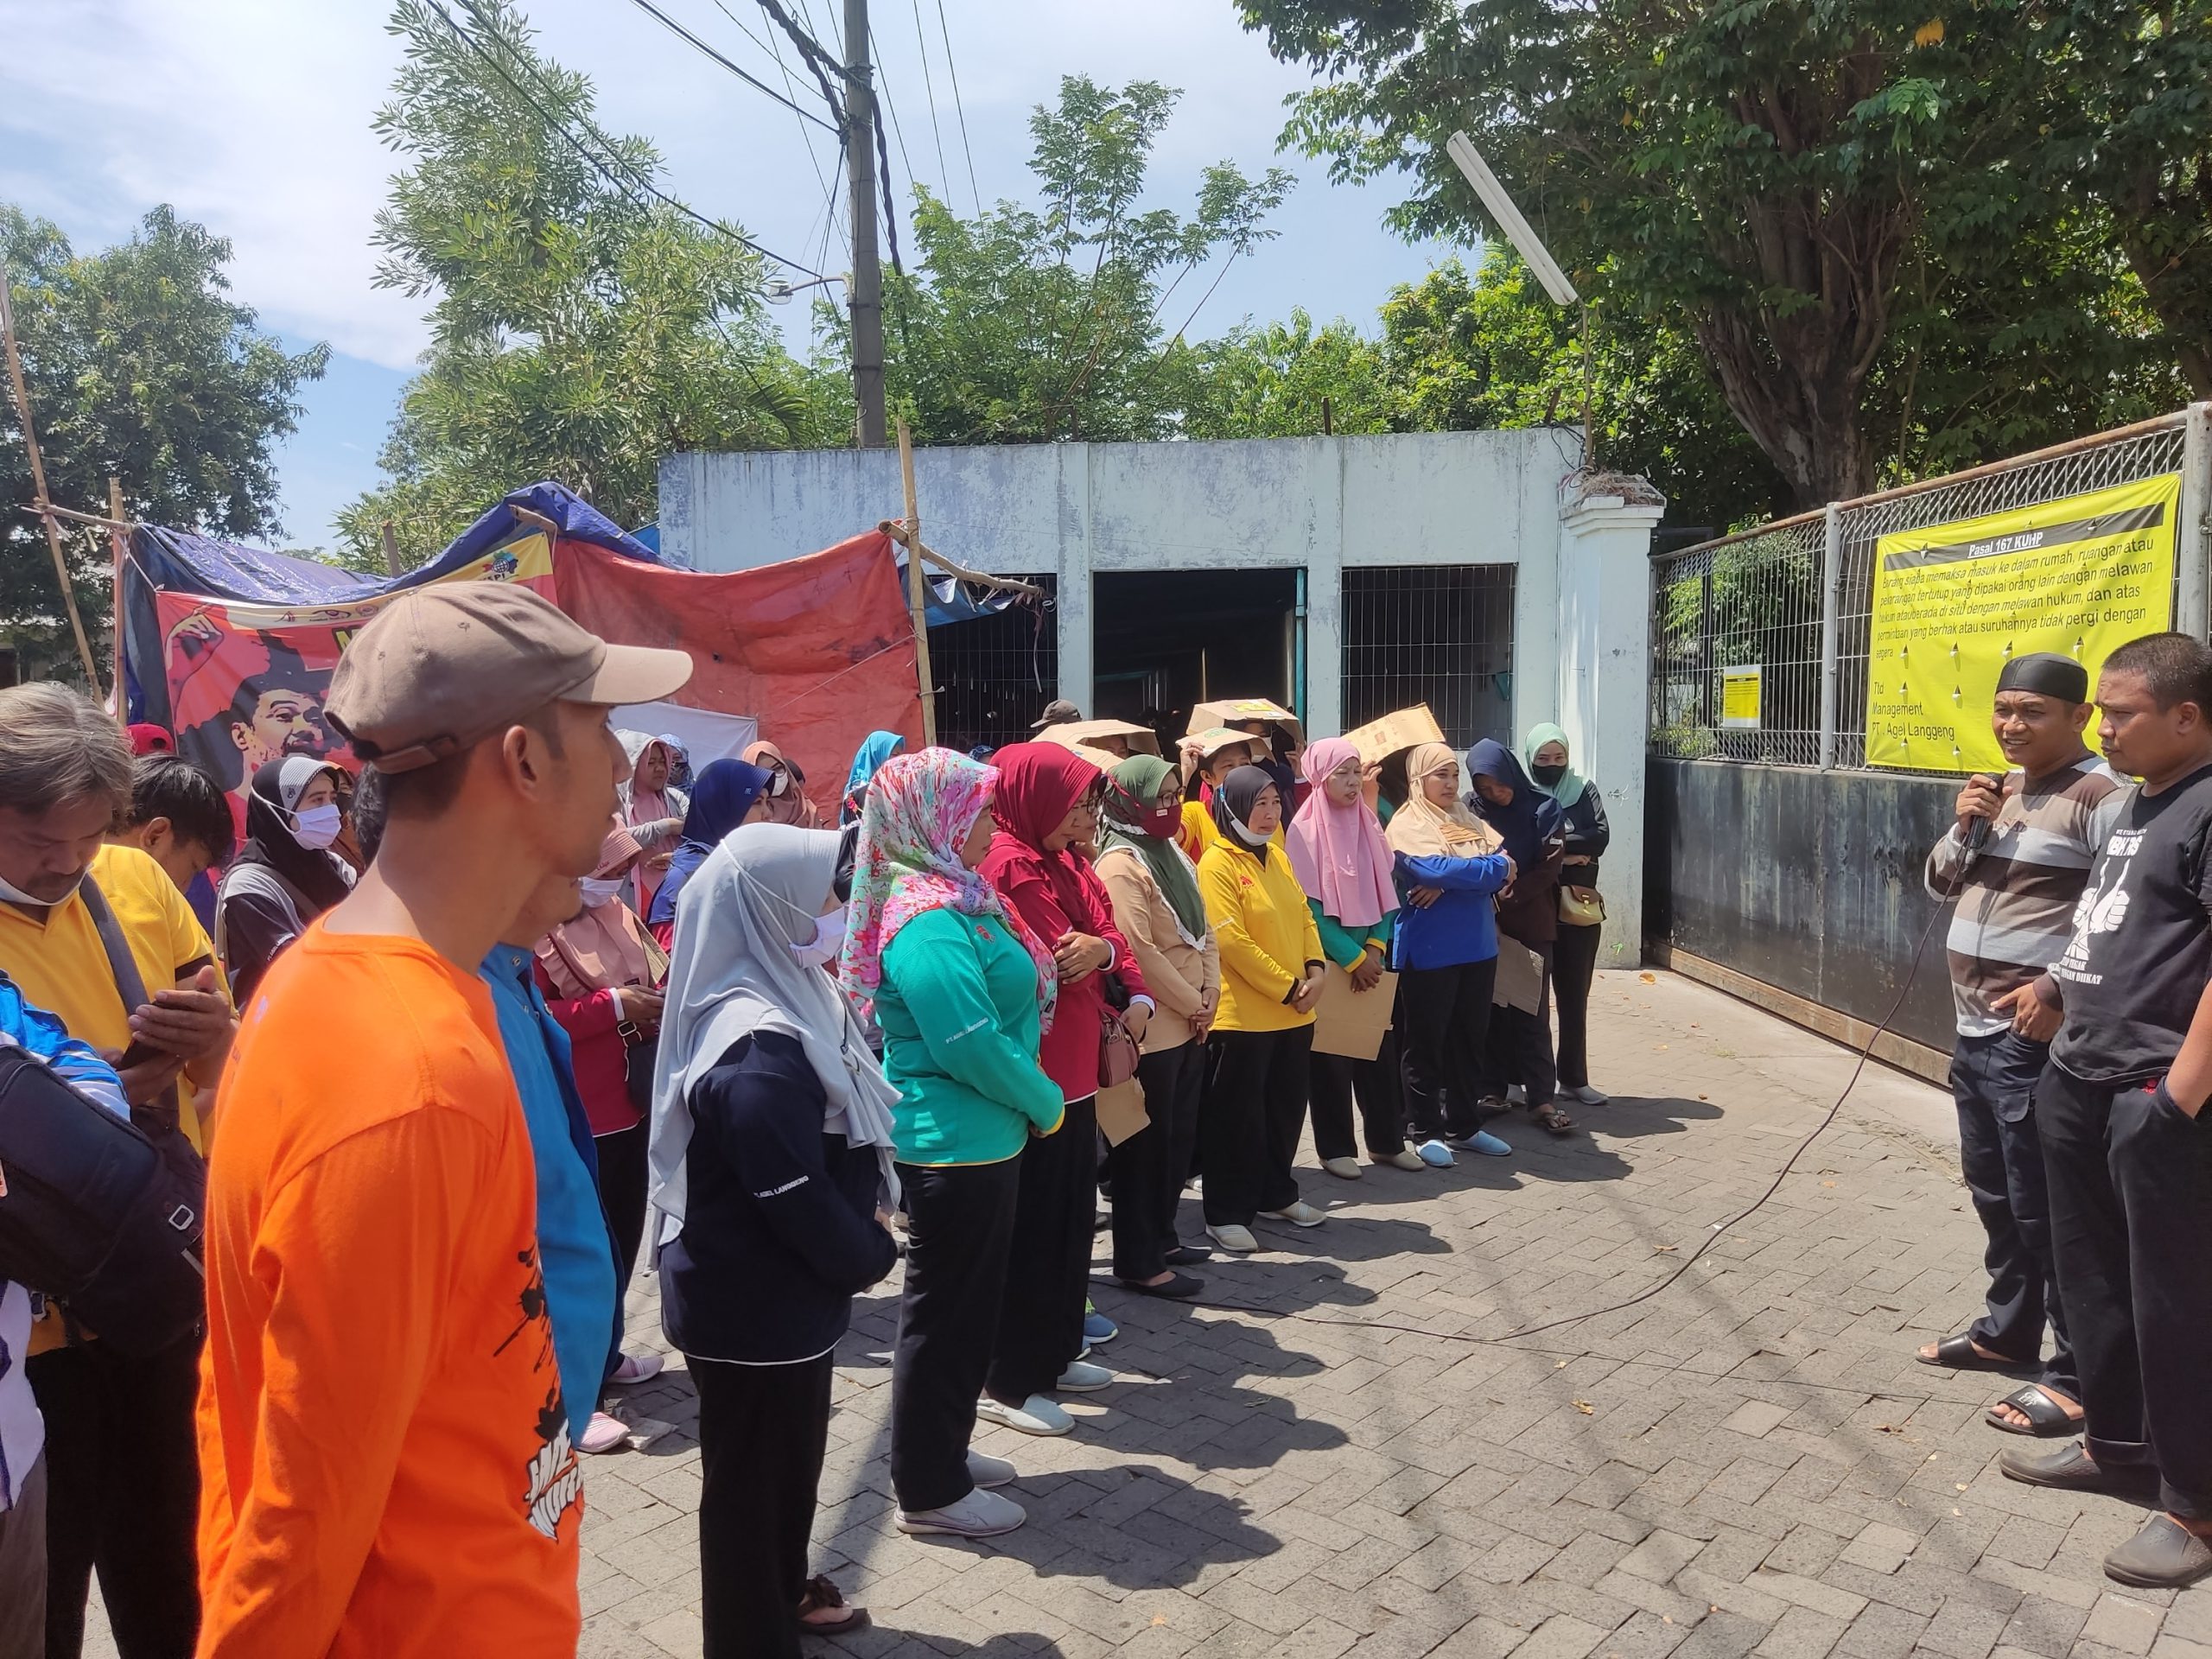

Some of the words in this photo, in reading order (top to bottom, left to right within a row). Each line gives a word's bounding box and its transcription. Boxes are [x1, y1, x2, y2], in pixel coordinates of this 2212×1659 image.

[1968, 543, 1993, 557] Pasal
[1996, 537, 2012, 553] 167
[2014, 531, 2044, 549] KUHP
[1904, 573, 1925, 588] siapa
[1926, 570, 1966, 584] memaksa
[1967, 564, 1997, 577] masuk
[1999, 561, 2010, 574] ke
[2011, 554, 2038, 572] dalam
[2078, 545, 2123, 562] ruangan
[2124, 538, 2154, 554] atau
[1917, 588, 1949, 603] tertutup
[1950, 585, 1973, 601] yang
[1974, 579, 2007, 596] dipakai
[2008, 577, 2037, 593] orang
[2037, 573, 2056, 588] lain
[2056, 569, 2097, 586] dengan
[2099, 561, 2153, 579] melawan
[1939, 605, 1948, 617] di
[1949, 603, 1965, 615] situ
[1967, 600, 2000, 616] dengan
[2000, 594, 2044, 612] melawan
[2046, 591, 2084, 607] hukum,
[2087, 588, 2112, 602] dan
[2116, 584, 2141, 600] atas
[1910, 627, 1928, 641] yang
[1929, 623, 1957, 637] berhak
[1959, 621, 1979, 634] atau
[1980, 617, 2037, 632] suruhannya
[2039, 613, 2064, 628] tidak
[2066, 608, 2099, 629] pergi
[2103, 607, 2147, 624] dengan
[1874, 682, 1884, 695] Ttd
[1872, 702, 1923, 719] Management
[1887, 722, 1906, 740] Agel
[1908, 722, 1955, 741] Langgeng
[2075, 971, 2103, 985] DIIKAT
